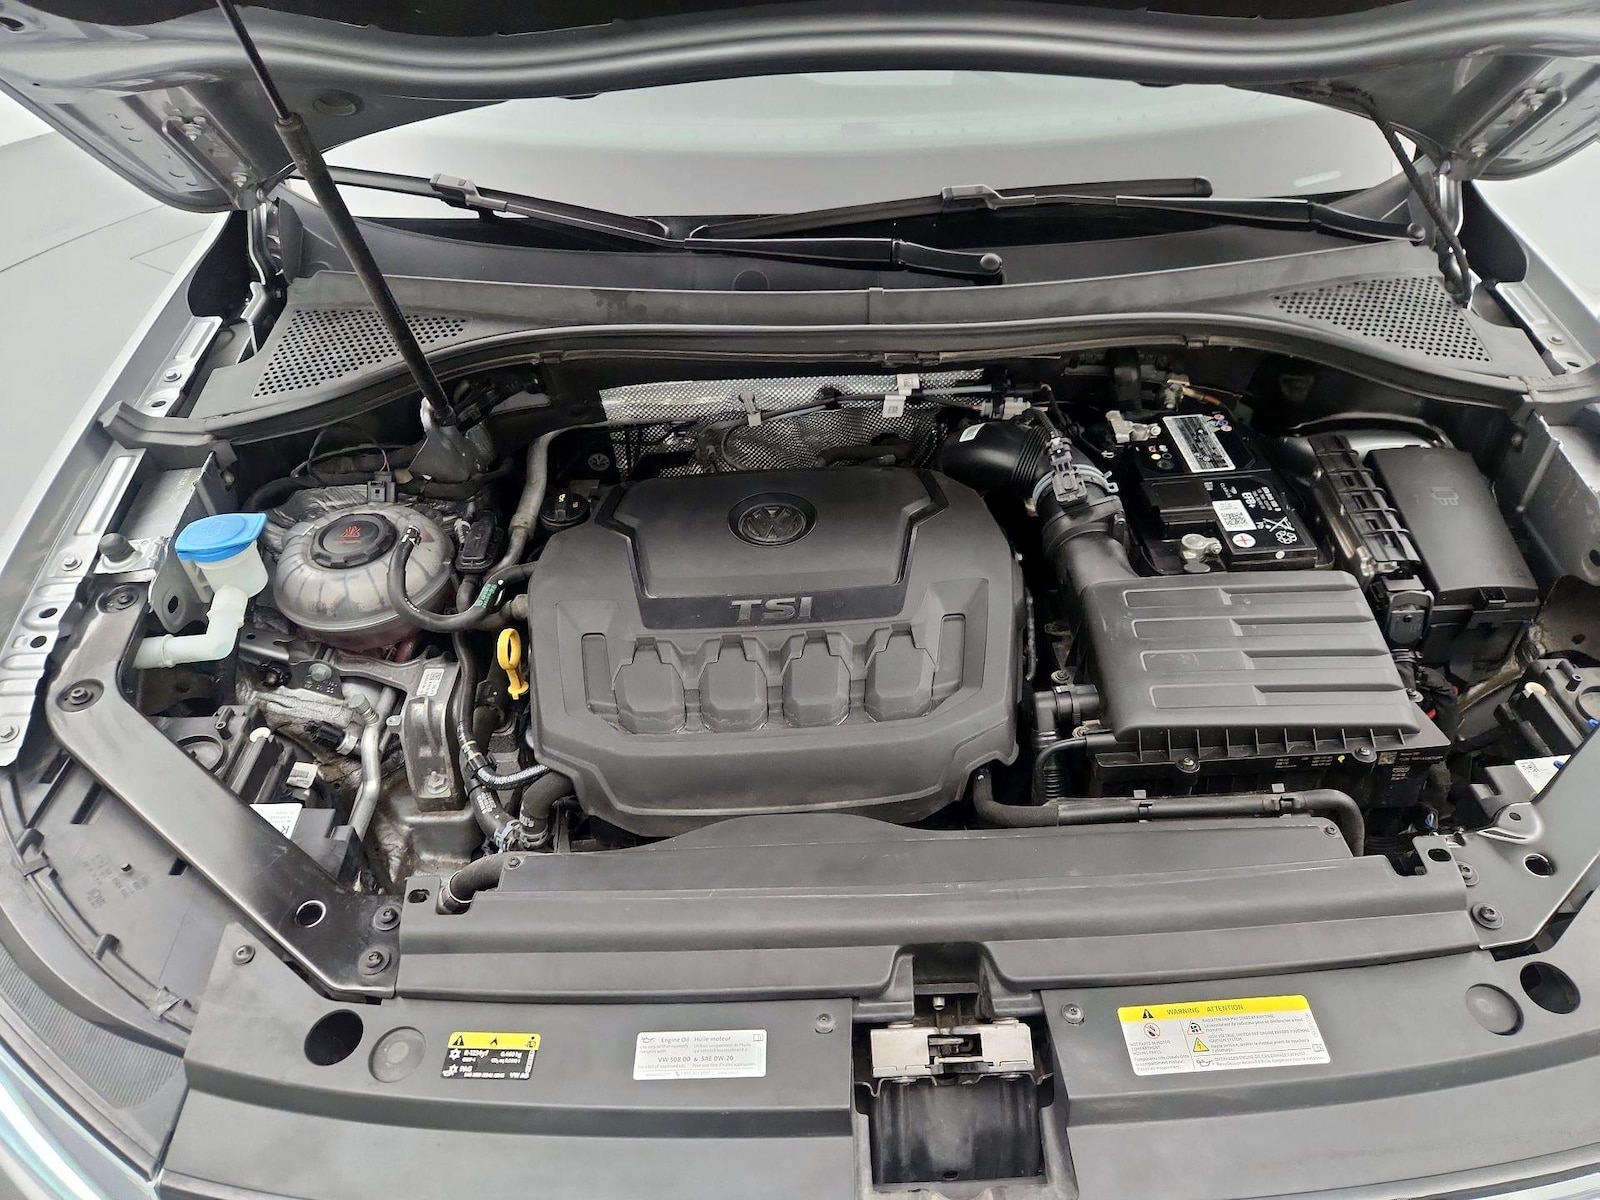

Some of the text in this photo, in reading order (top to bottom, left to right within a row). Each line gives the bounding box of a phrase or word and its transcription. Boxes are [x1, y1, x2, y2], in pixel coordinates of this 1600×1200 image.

[731, 596, 813, 622] TSI
[1166, 1004, 1244, 1016] WARNING ATTENTION
